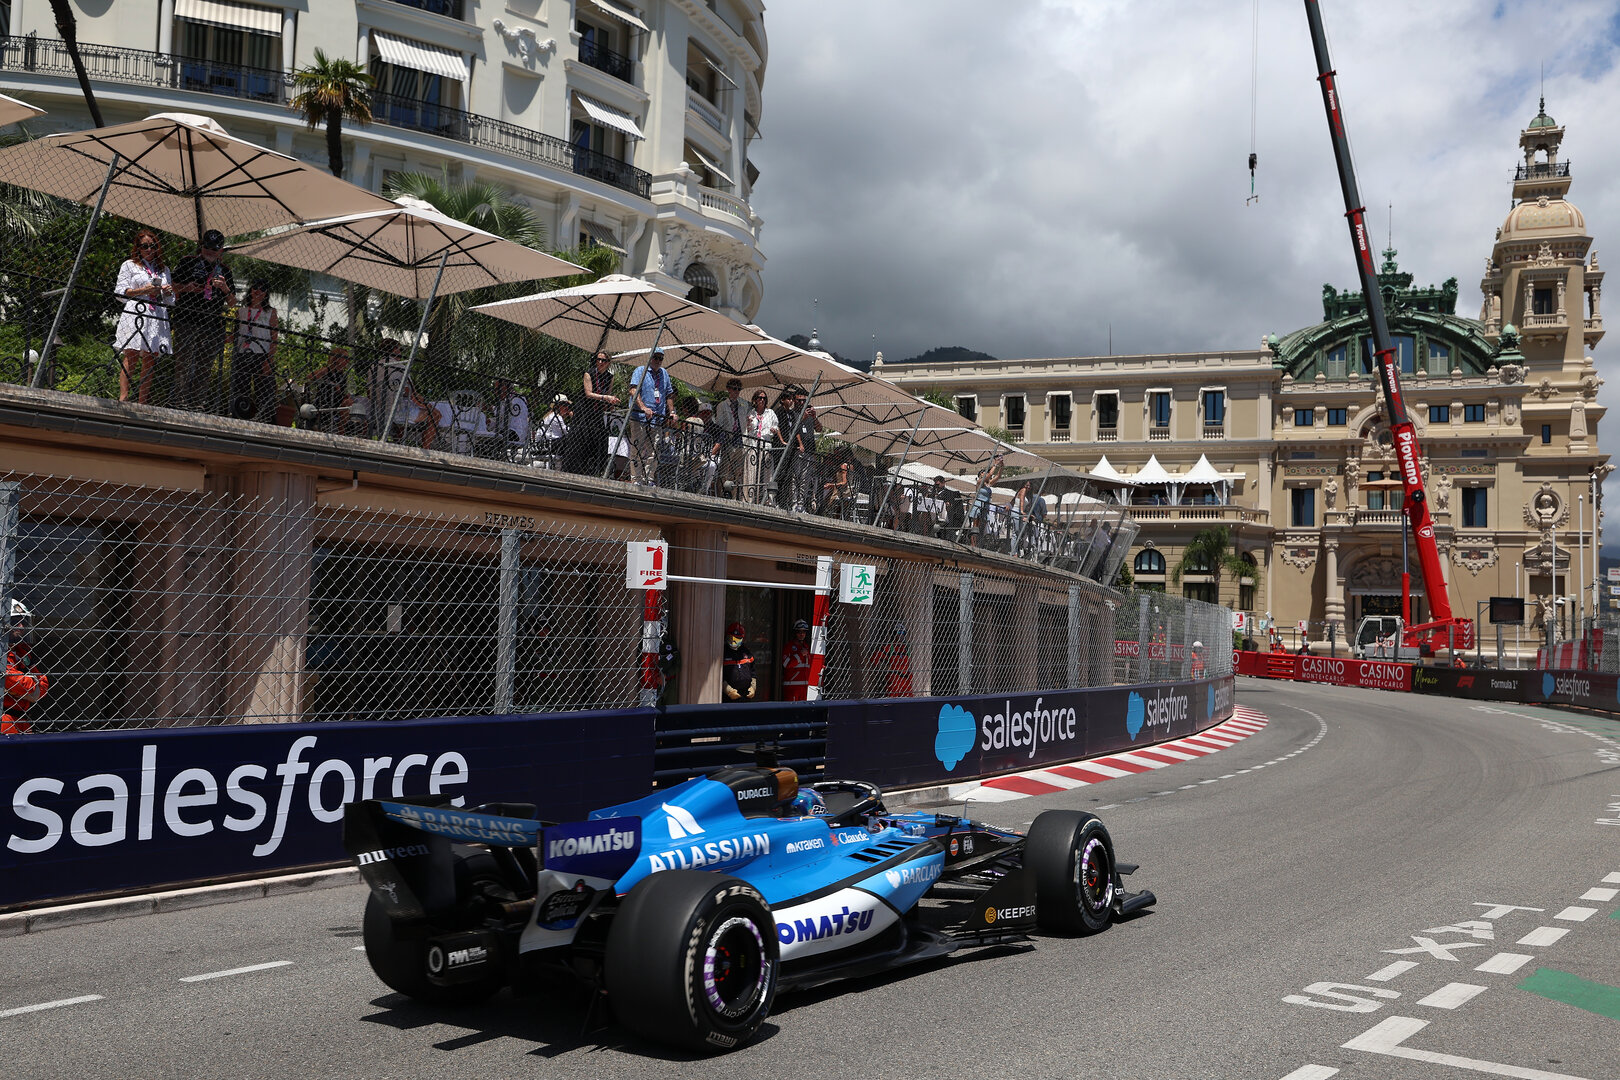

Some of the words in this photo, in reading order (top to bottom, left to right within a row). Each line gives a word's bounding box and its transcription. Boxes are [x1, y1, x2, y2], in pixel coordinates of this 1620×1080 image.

[1355, 223, 1366, 251] Piovano
[1385, 363, 1397, 393] Piovano
[1398, 431, 1418, 485] Piovano
[639, 569, 663, 577] FIRE
[1301, 658, 1345, 675] CASINO
[1359, 663, 1404, 681] CASINO
[1491, 678, 1512, 689] Formula
[1555, 673, 1590, 701] salesforce
[1146, 686, 1188, 733] salesforce
[981, 697, 1076, 759] salesforce
[6, 735, 470, 857] salesforce
[737, 787, 774, 801] DURACELL
[423, 811, 528, 843] BARCLAYS
[838, 830, 870, 844] Claude
[357, 843, 430, 866] nuveen
[549, 828, 635, 858] KOMATSU
[648, 833, 770, 873] ATLASSIAN
[715, 889, 728, 905] P
[729, 885, 771, 912] ZERO
[997, 905, 1036, 920] KEEPER
[777, 906, 874, 945] OMATSU
[1281, 902, 1545, 1013] TAXIS
